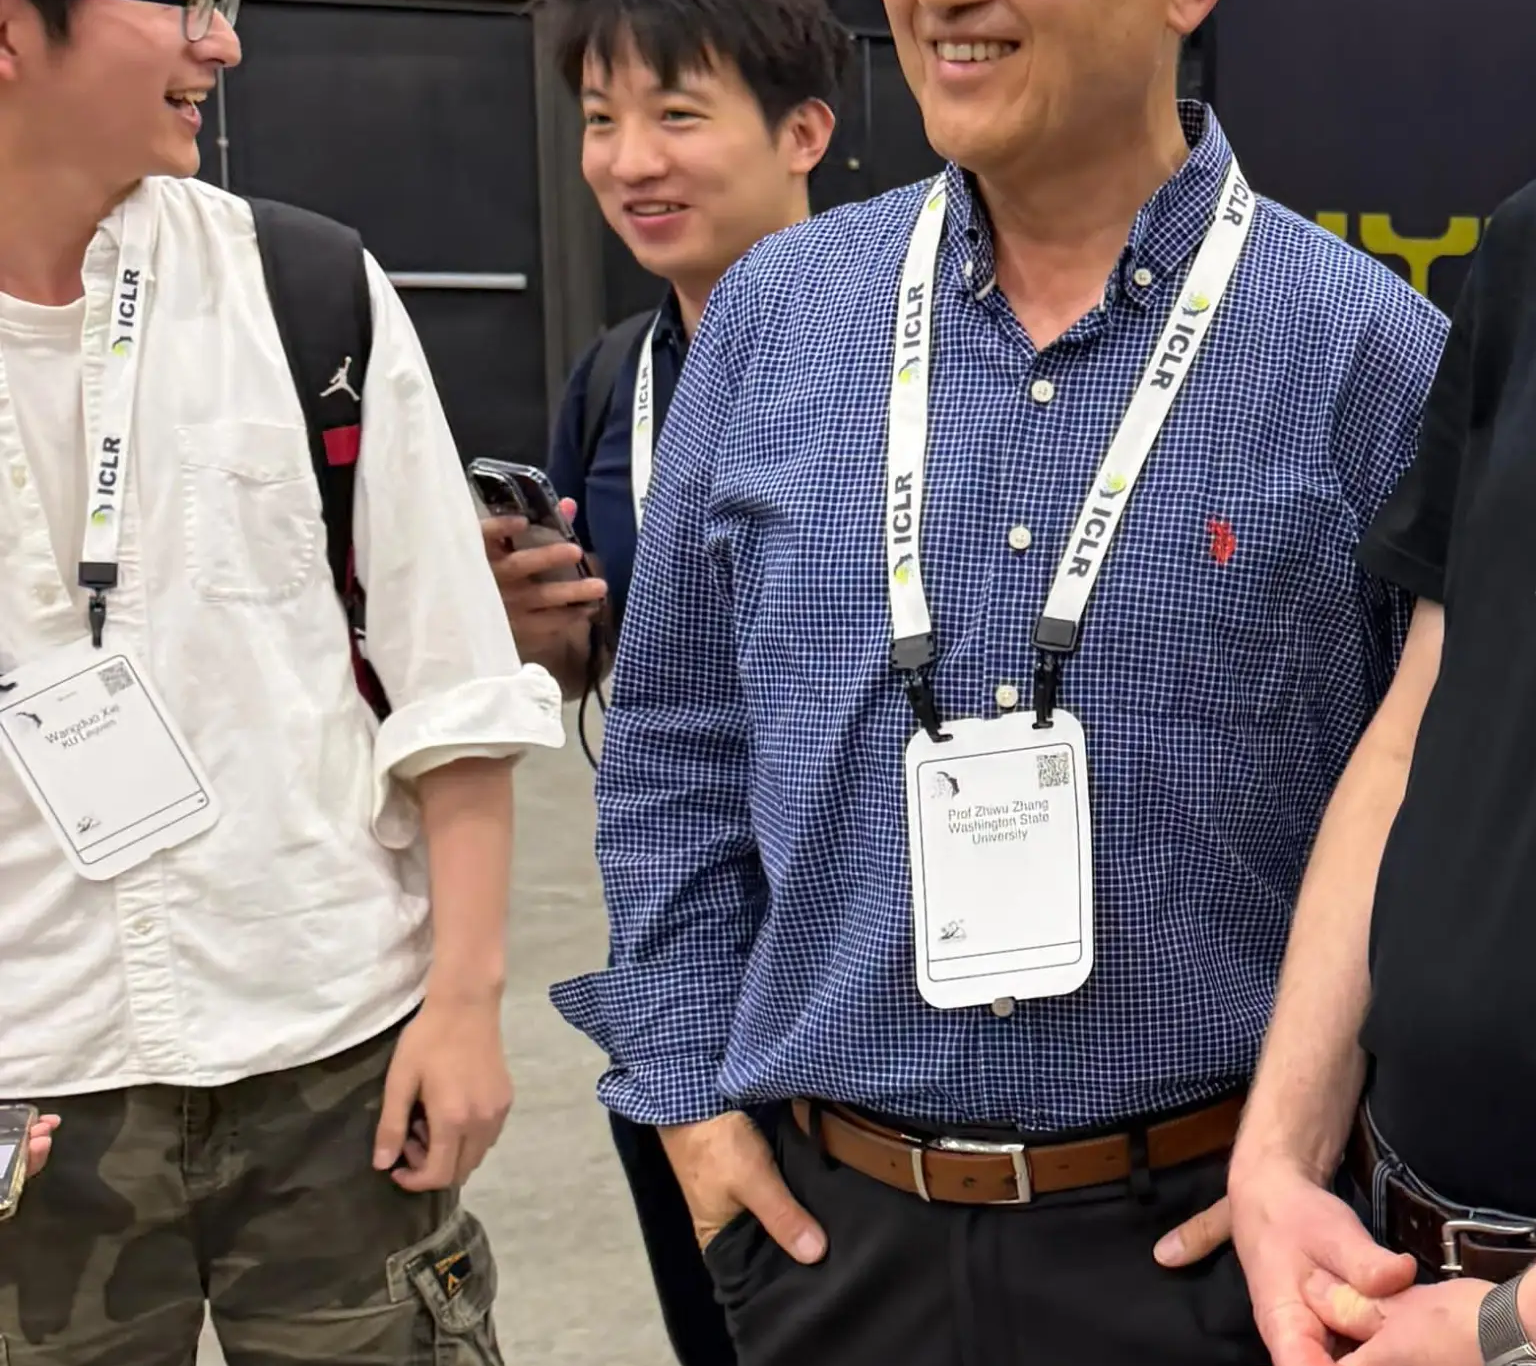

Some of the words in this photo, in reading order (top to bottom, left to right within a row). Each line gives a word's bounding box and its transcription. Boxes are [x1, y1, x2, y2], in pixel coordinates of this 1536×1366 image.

[1222, 175, 1249, 226] ICLR
[118, 268, 140, 327] ICLR
[904, 282, 926, 355] ICLR
[1150, 323, 1195, 391] ICLR
[97, 436, 121, 496] ICLR
[893, 471, 913, 544] ICLR
[1067, 506, 1113, 579] ICLR
[948, 807, 972, 821] Prof
[974, 805, 1009, 817] Zhiwu
[1012, 799, 1050, 813] Zhang
[948, 816, 1017, 834] Washington
[1020, 813, 1050, 825] State
[972, 829, 1029, 845] University
